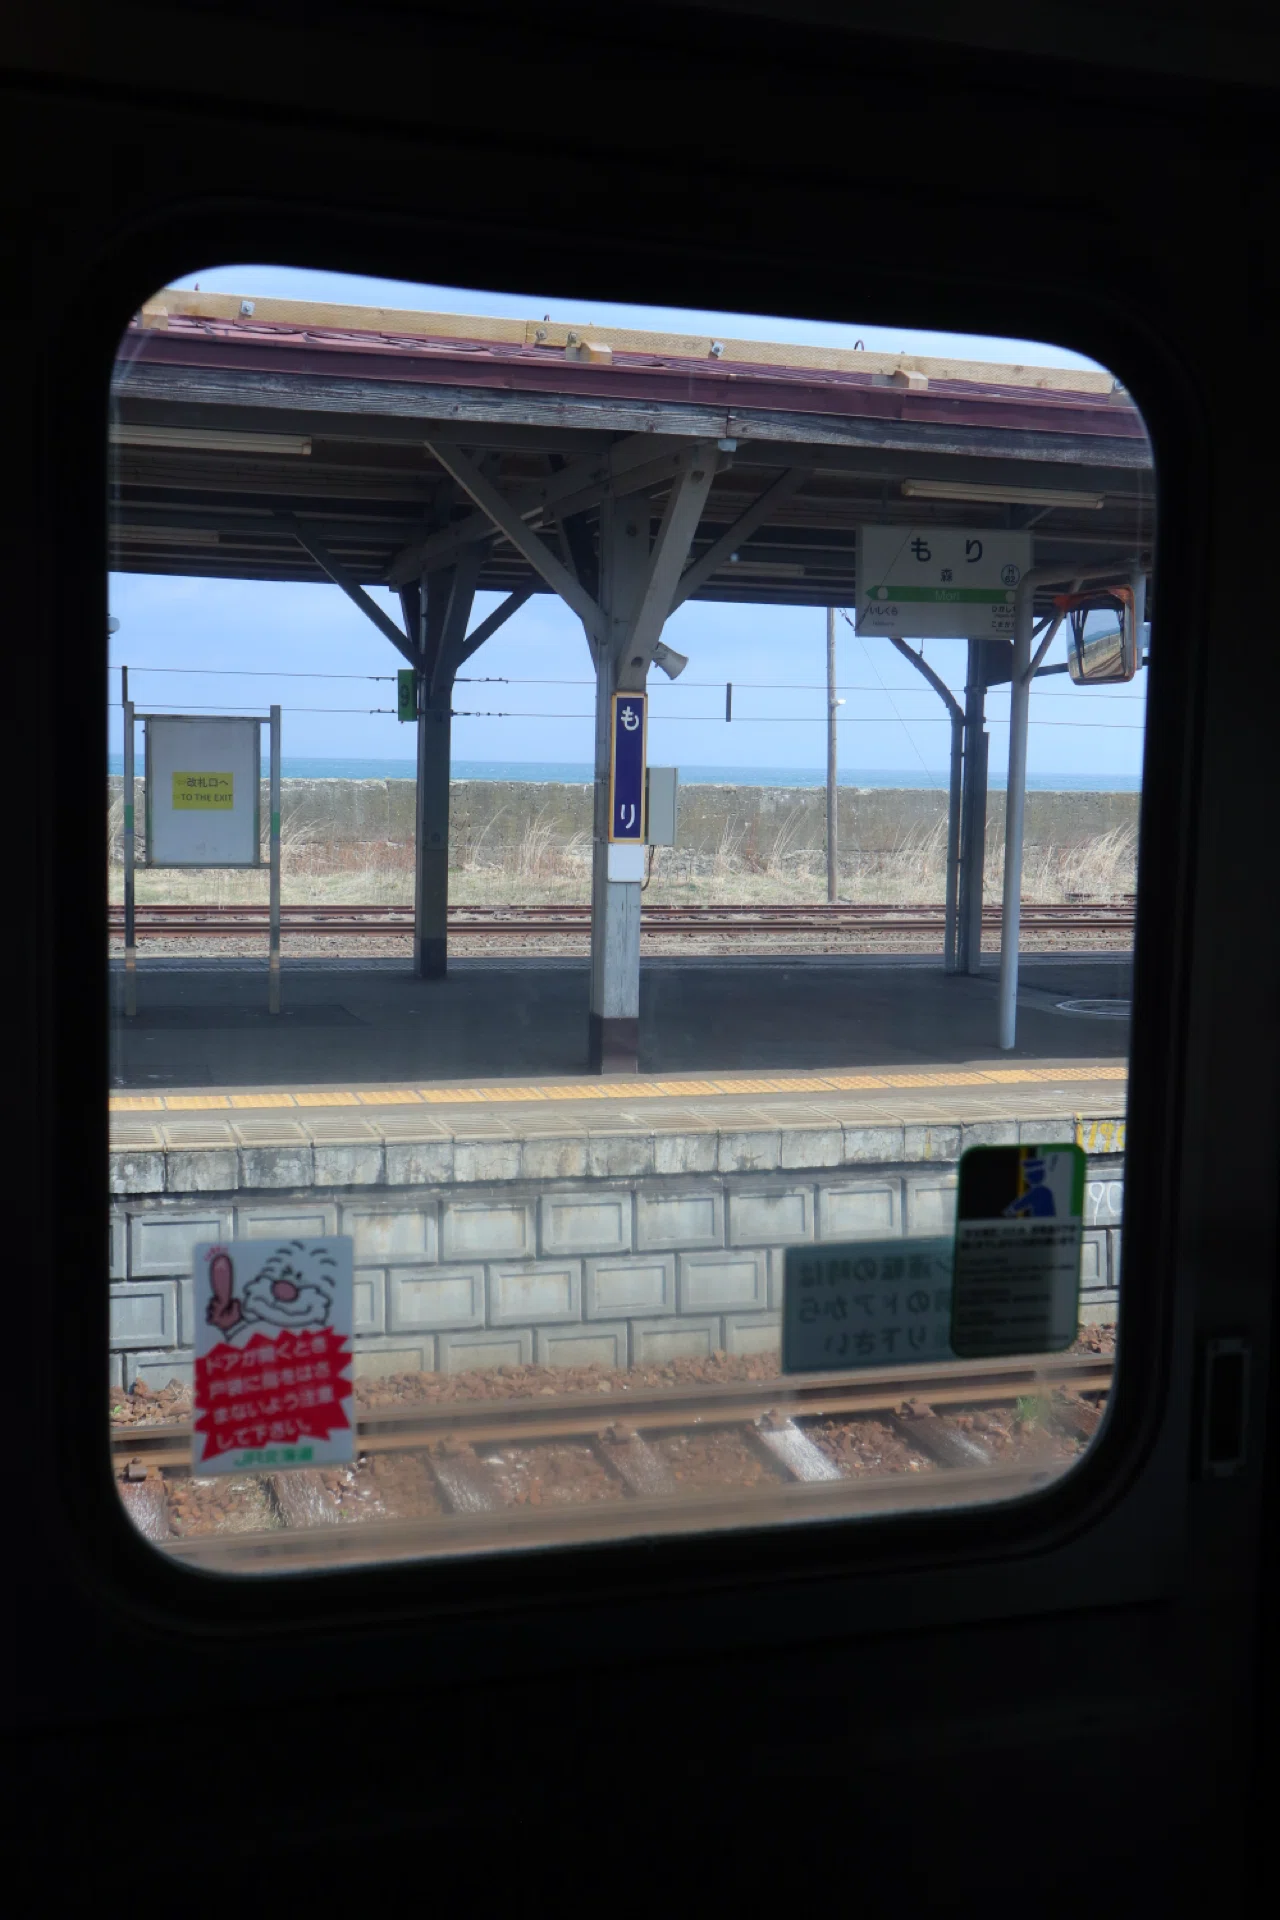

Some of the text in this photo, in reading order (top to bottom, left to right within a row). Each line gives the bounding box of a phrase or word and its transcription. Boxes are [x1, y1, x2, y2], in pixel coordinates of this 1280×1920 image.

[911, 537, 983, 563] もり
[941, 568, 953, 582] 森
[935, 590, 960, 600] Mori
[870, 606, 898, 616] いしくら
[620, 706, 639, 829] もり
[187, 776, 228, 788] 改札口へ
[181, 793, 233, 802] TO THE EXIT
